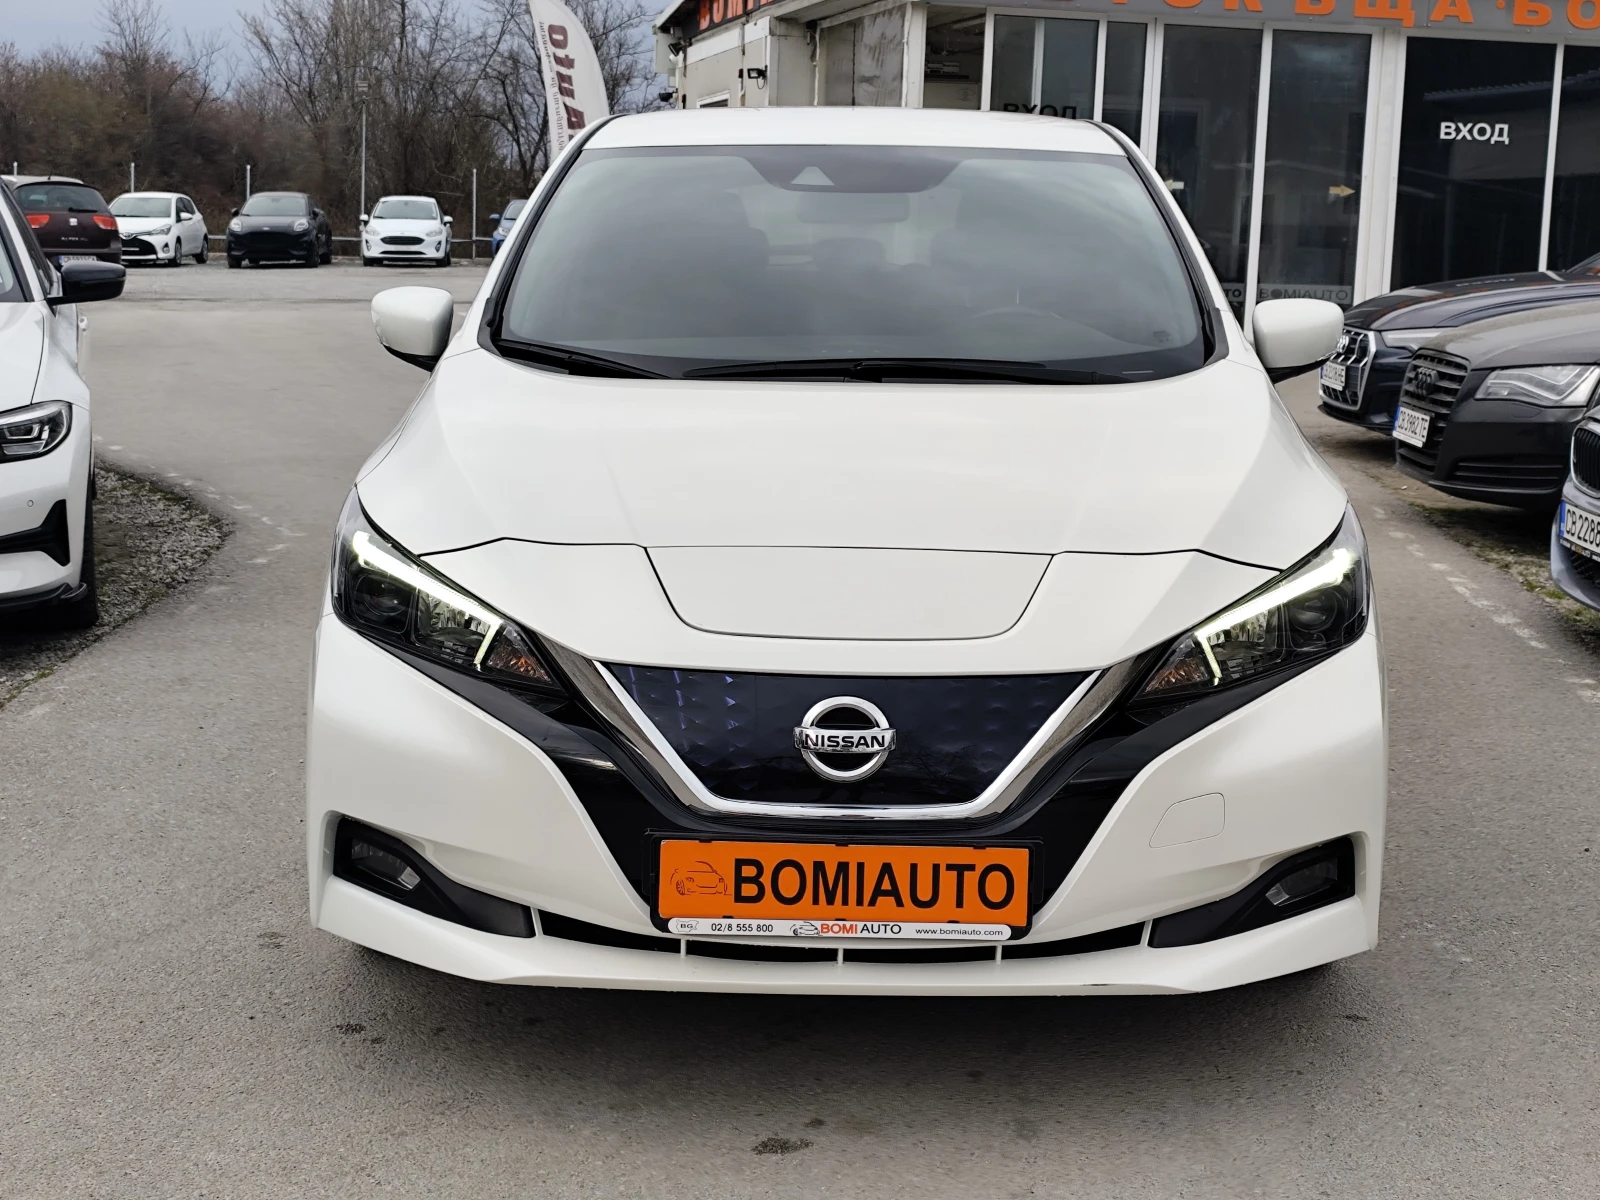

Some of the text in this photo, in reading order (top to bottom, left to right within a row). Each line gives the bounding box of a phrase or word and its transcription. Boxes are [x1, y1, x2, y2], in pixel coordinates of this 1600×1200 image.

[1440, 122, 1509, 145] ВХОД
[804, 734, 885, 748] NISSAN
[733, 858, 1015, 910] BOMIAUTO
[711, 923, 733, 933] 02/8
[736, 923, 753, 932] 555
[756, 924, 773, 933] 800
[820, 923, 858, 934] BOMI
[860, 924, 902, 935] AUTO
[915, 927, 1003, 937] www.bomiauto.com
